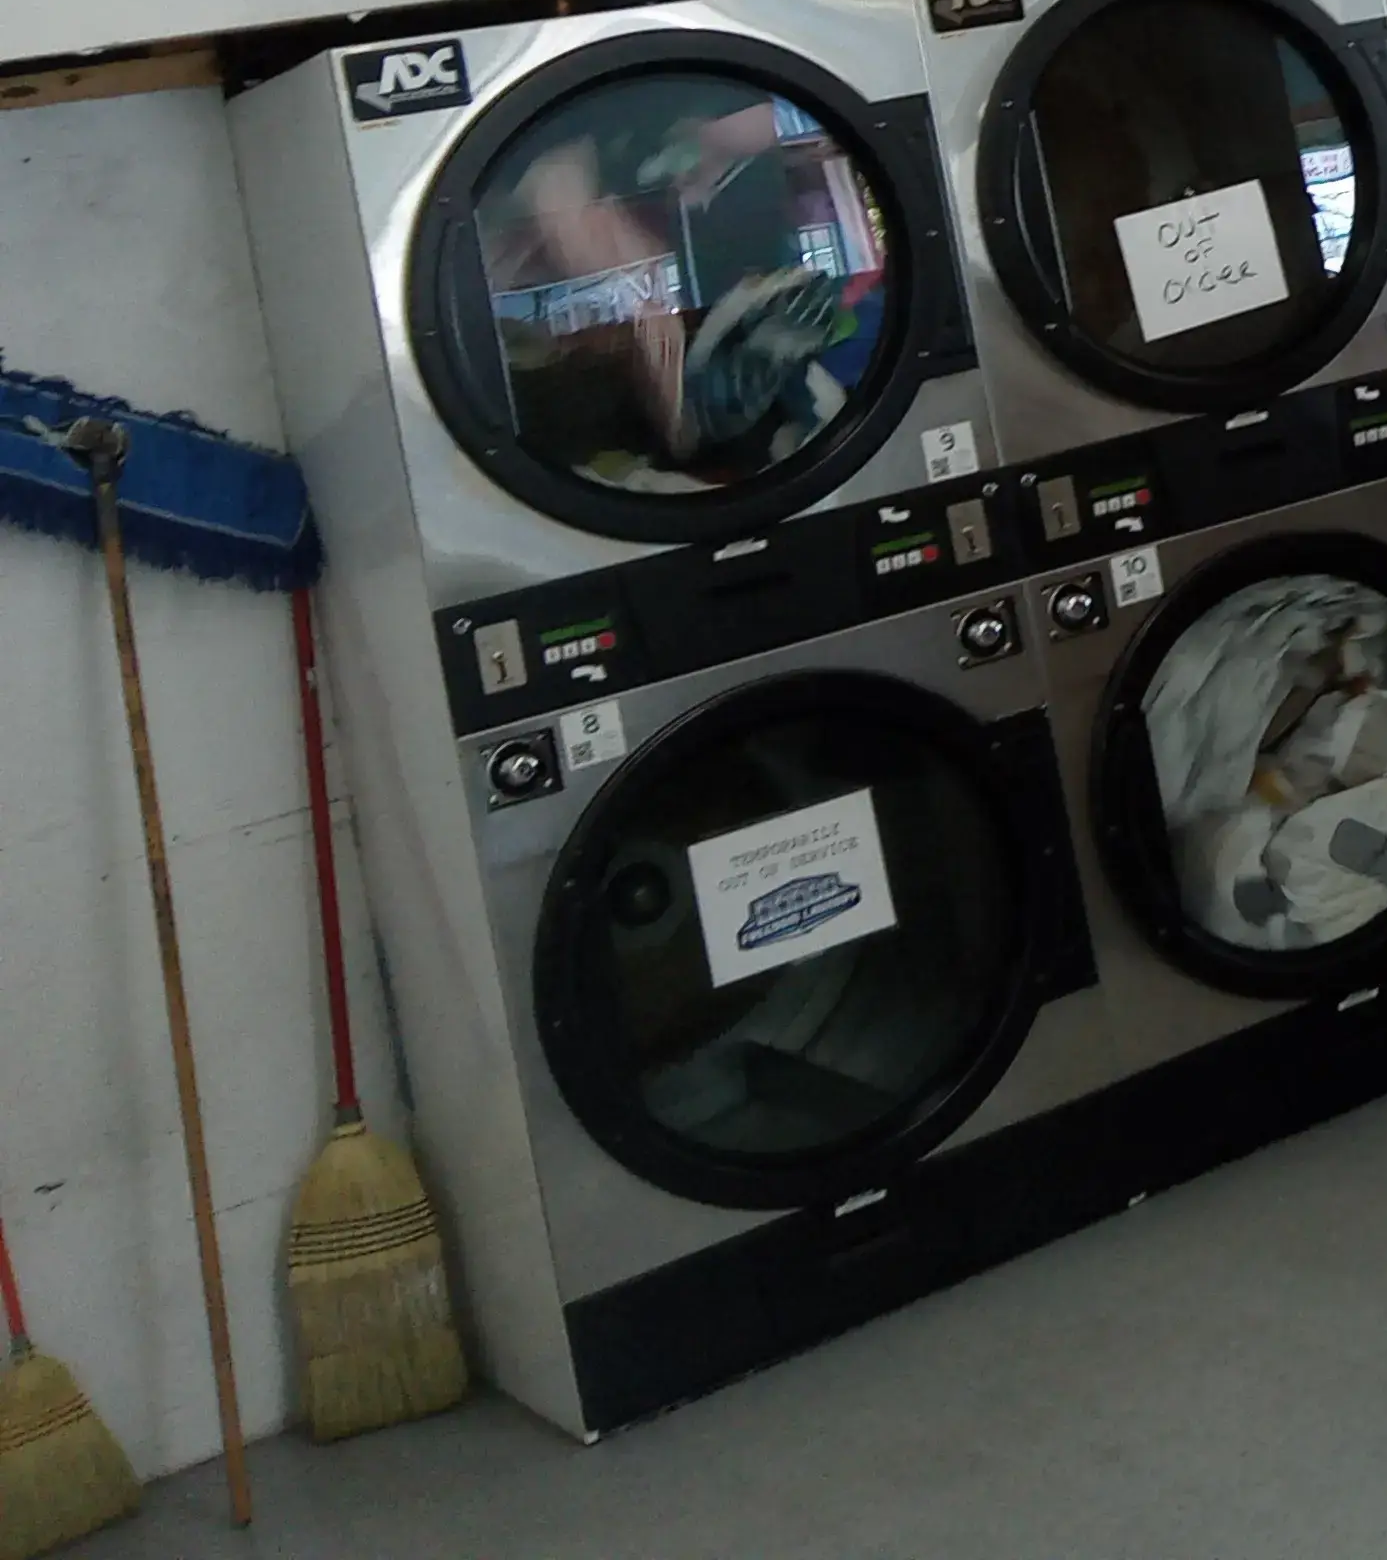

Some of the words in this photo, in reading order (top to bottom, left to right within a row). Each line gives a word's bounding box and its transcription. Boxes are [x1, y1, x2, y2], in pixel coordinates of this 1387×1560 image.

[378, 45, 459, 94] ADC
[1157, 212, 1221, 249] OUT
[1183, 237, 1215, 263] OF
[1119, 555, 1147, 577] 10
[582, 713, 600, 735] 8
